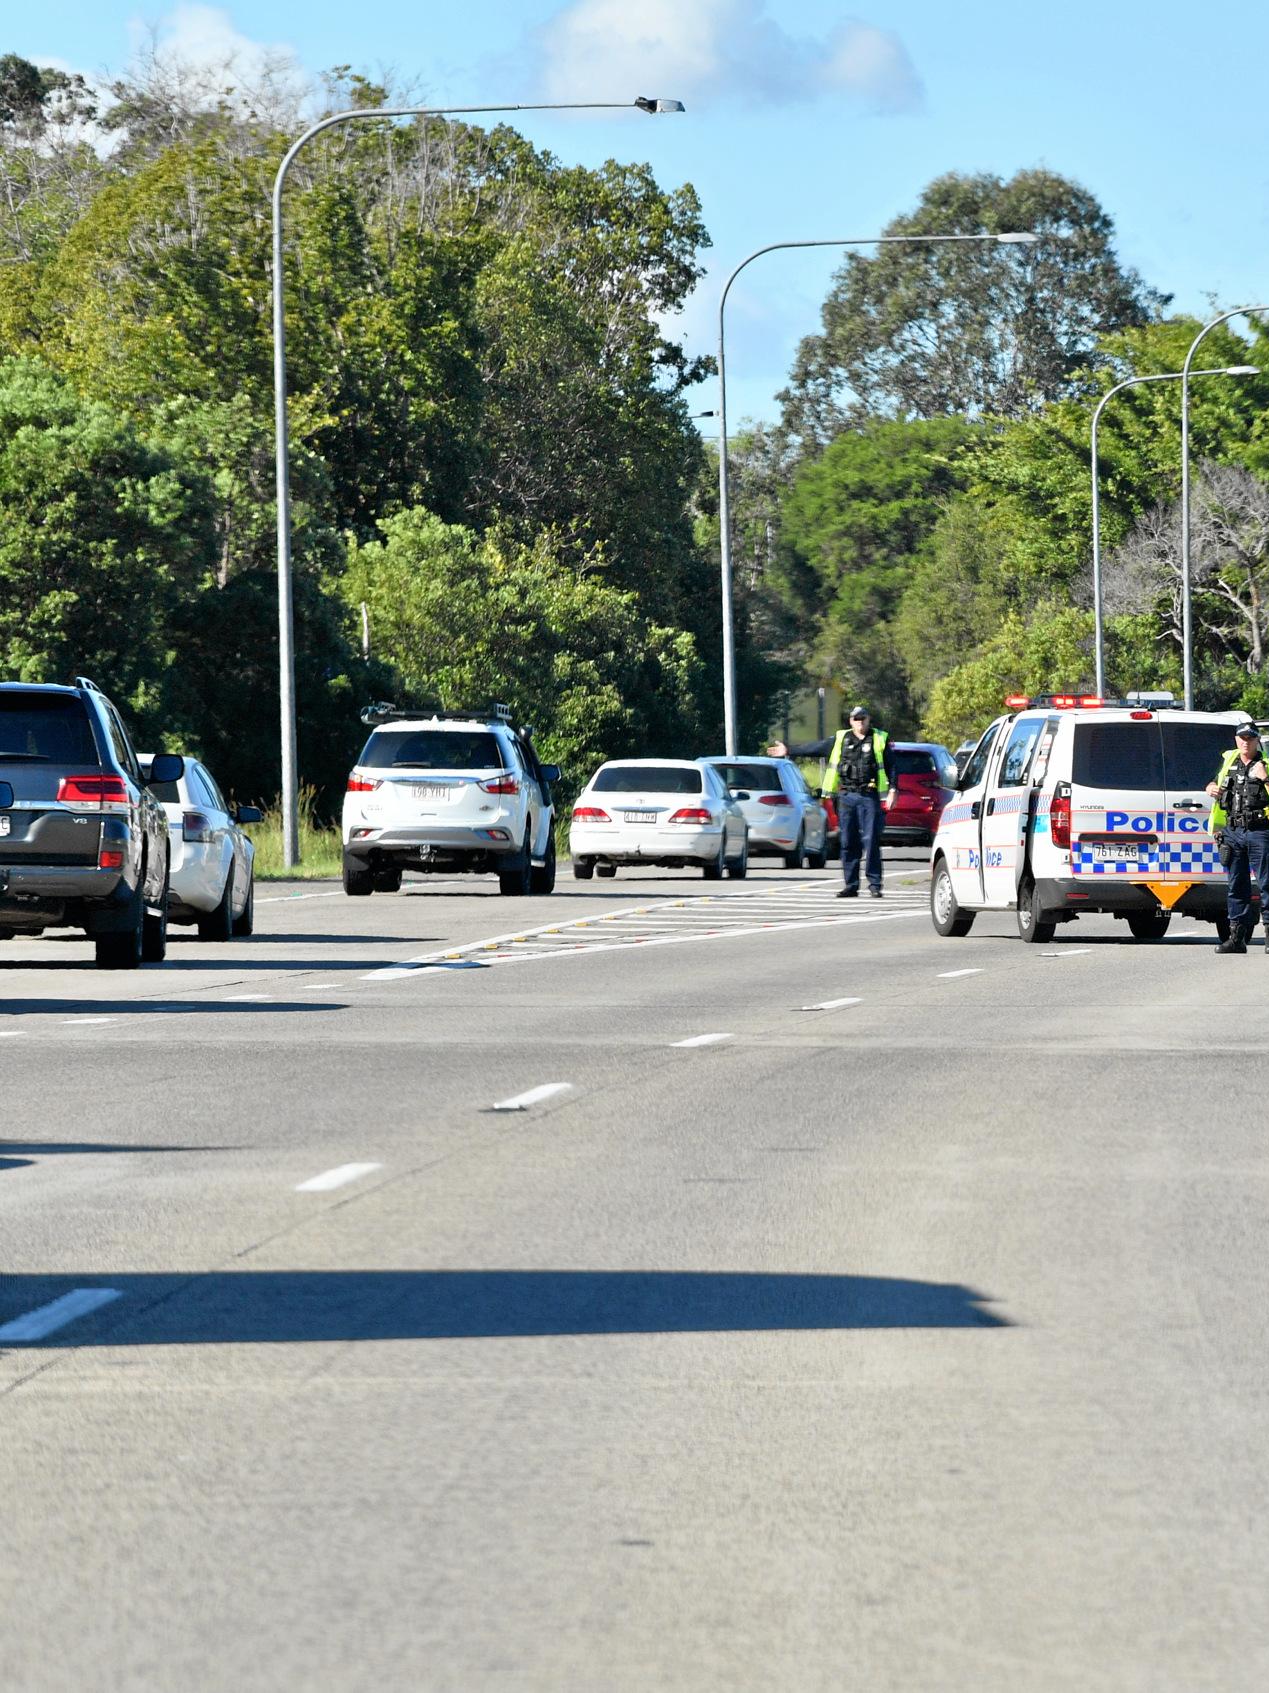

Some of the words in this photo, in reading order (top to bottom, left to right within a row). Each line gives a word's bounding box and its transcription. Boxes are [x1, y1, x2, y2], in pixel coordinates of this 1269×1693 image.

[1105, 811, 1209, 833] Polic
[1095, 846, 1112, 857] 761
[1116, 846, 1137, 857] ZAG
